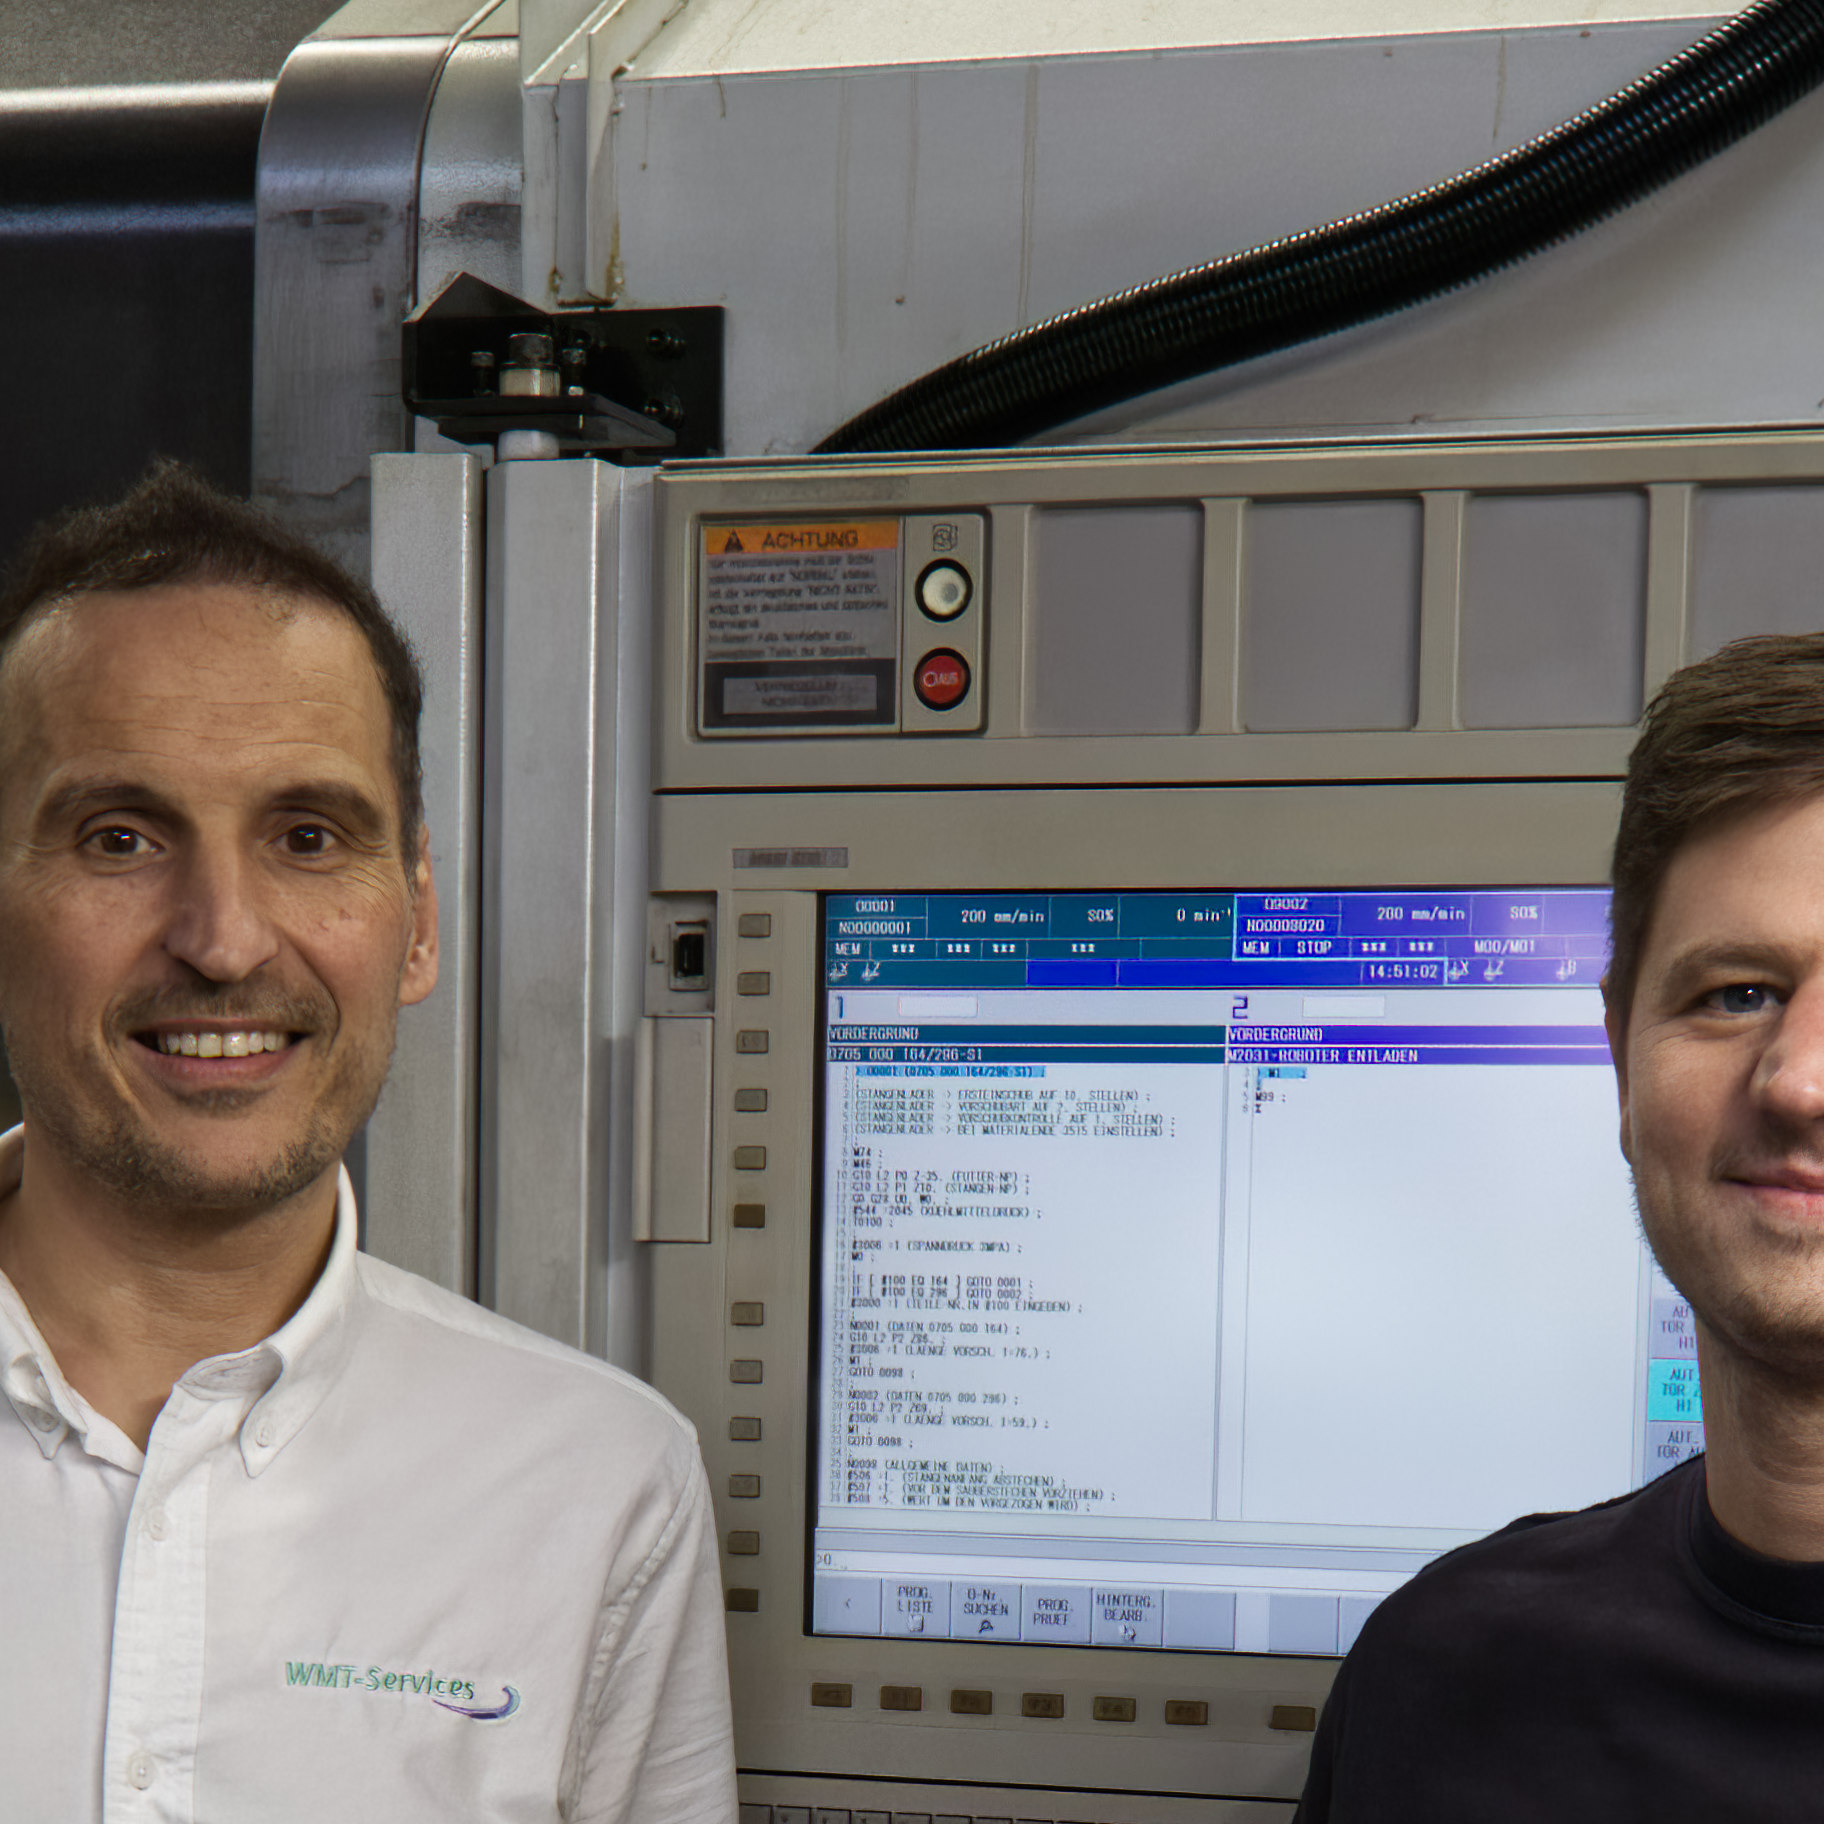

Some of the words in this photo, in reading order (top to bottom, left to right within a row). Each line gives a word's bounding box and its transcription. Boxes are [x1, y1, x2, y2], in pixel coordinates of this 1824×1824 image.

[761, 530, 859, 548] ACHTUNG
[1377, 906, 1404, 920] 200
[1411, 906, 1465, 920] mm/min
[835, 943, 861, 955] MEM
[1243, 941, 1270, 954] MEM
[1297, 941, 1332, 954] STOP
[1369, 964, 1438, 978] 14:51:02
[1232, 995, 1249, 1019] 2
[829, 1027, 919, 1041] VORDERGRUND
[1228, 1027, 1324, 1042] VORDERGRUND
[1347, 1048, 1419, 1063] ENTLADEN
[1661, 1321, 1685, 1334] TOR
[1661, 1383, 1686, 1397] TOR
[1657, 1445, 1681, 1459] TOR
[897, 1599, 933, 1614] LISTE
[963, 1602, 1009, 1617] SUCHEN
[284, 1661, 475, 1700] WMT-Services
